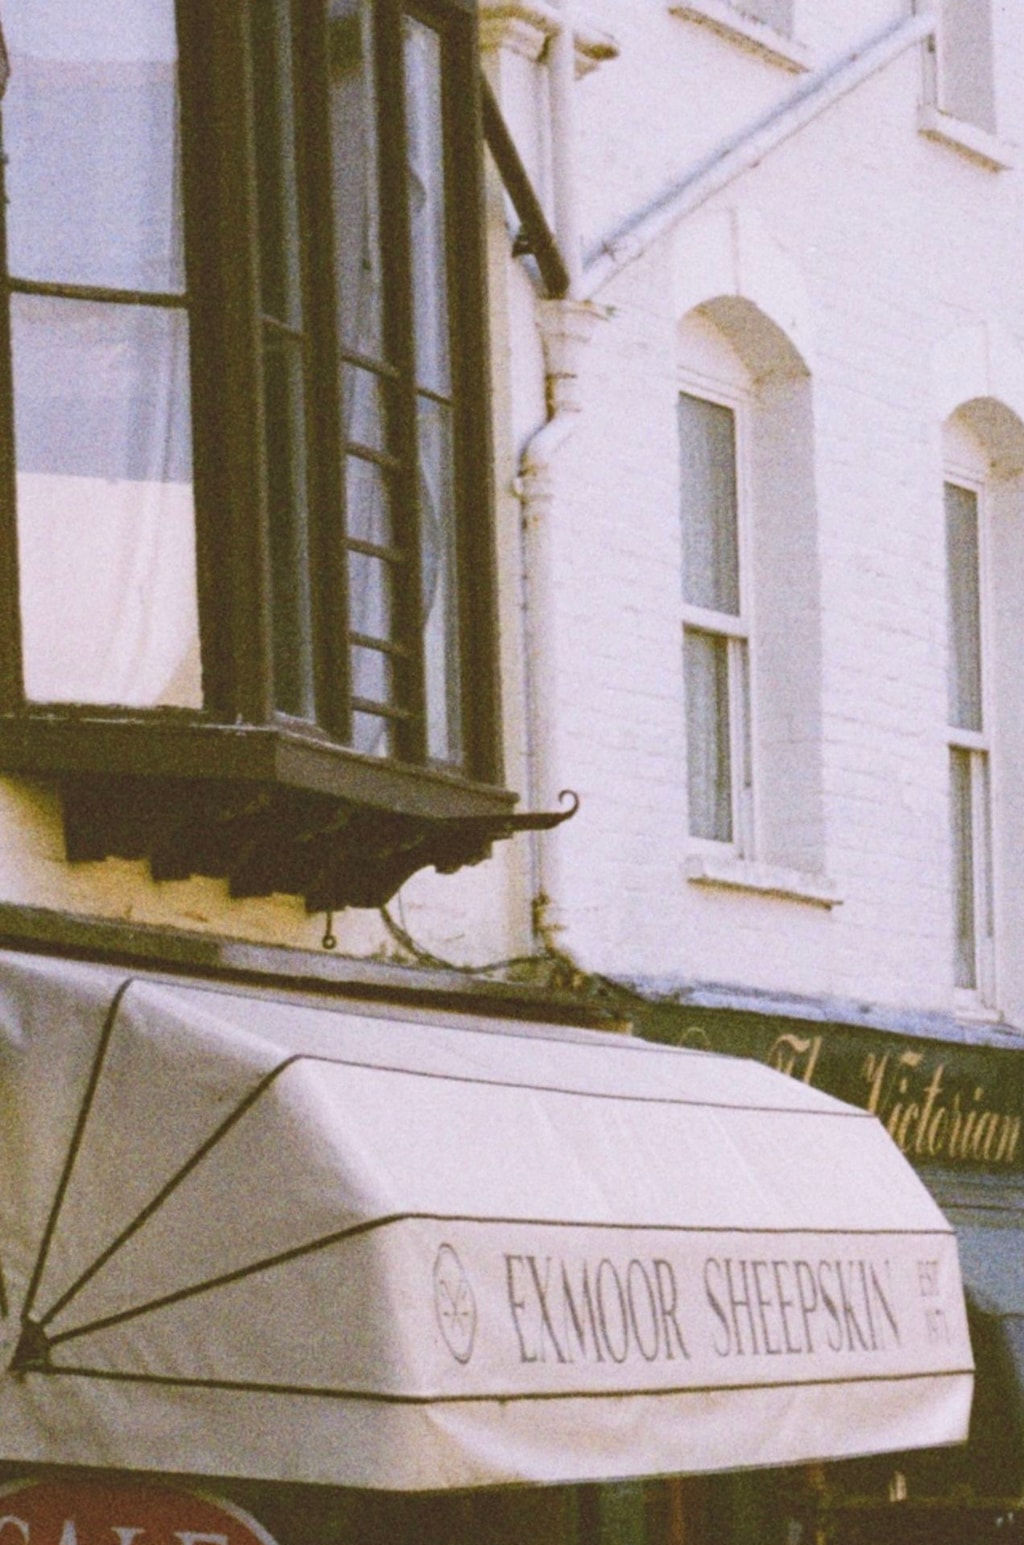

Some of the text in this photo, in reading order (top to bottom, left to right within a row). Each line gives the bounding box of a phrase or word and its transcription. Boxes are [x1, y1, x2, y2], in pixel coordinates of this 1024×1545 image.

[865, 1048, 1021, 1163] Victorian
[502, 1252, 902, 1365] EXMOOR SHEEPSKIN
